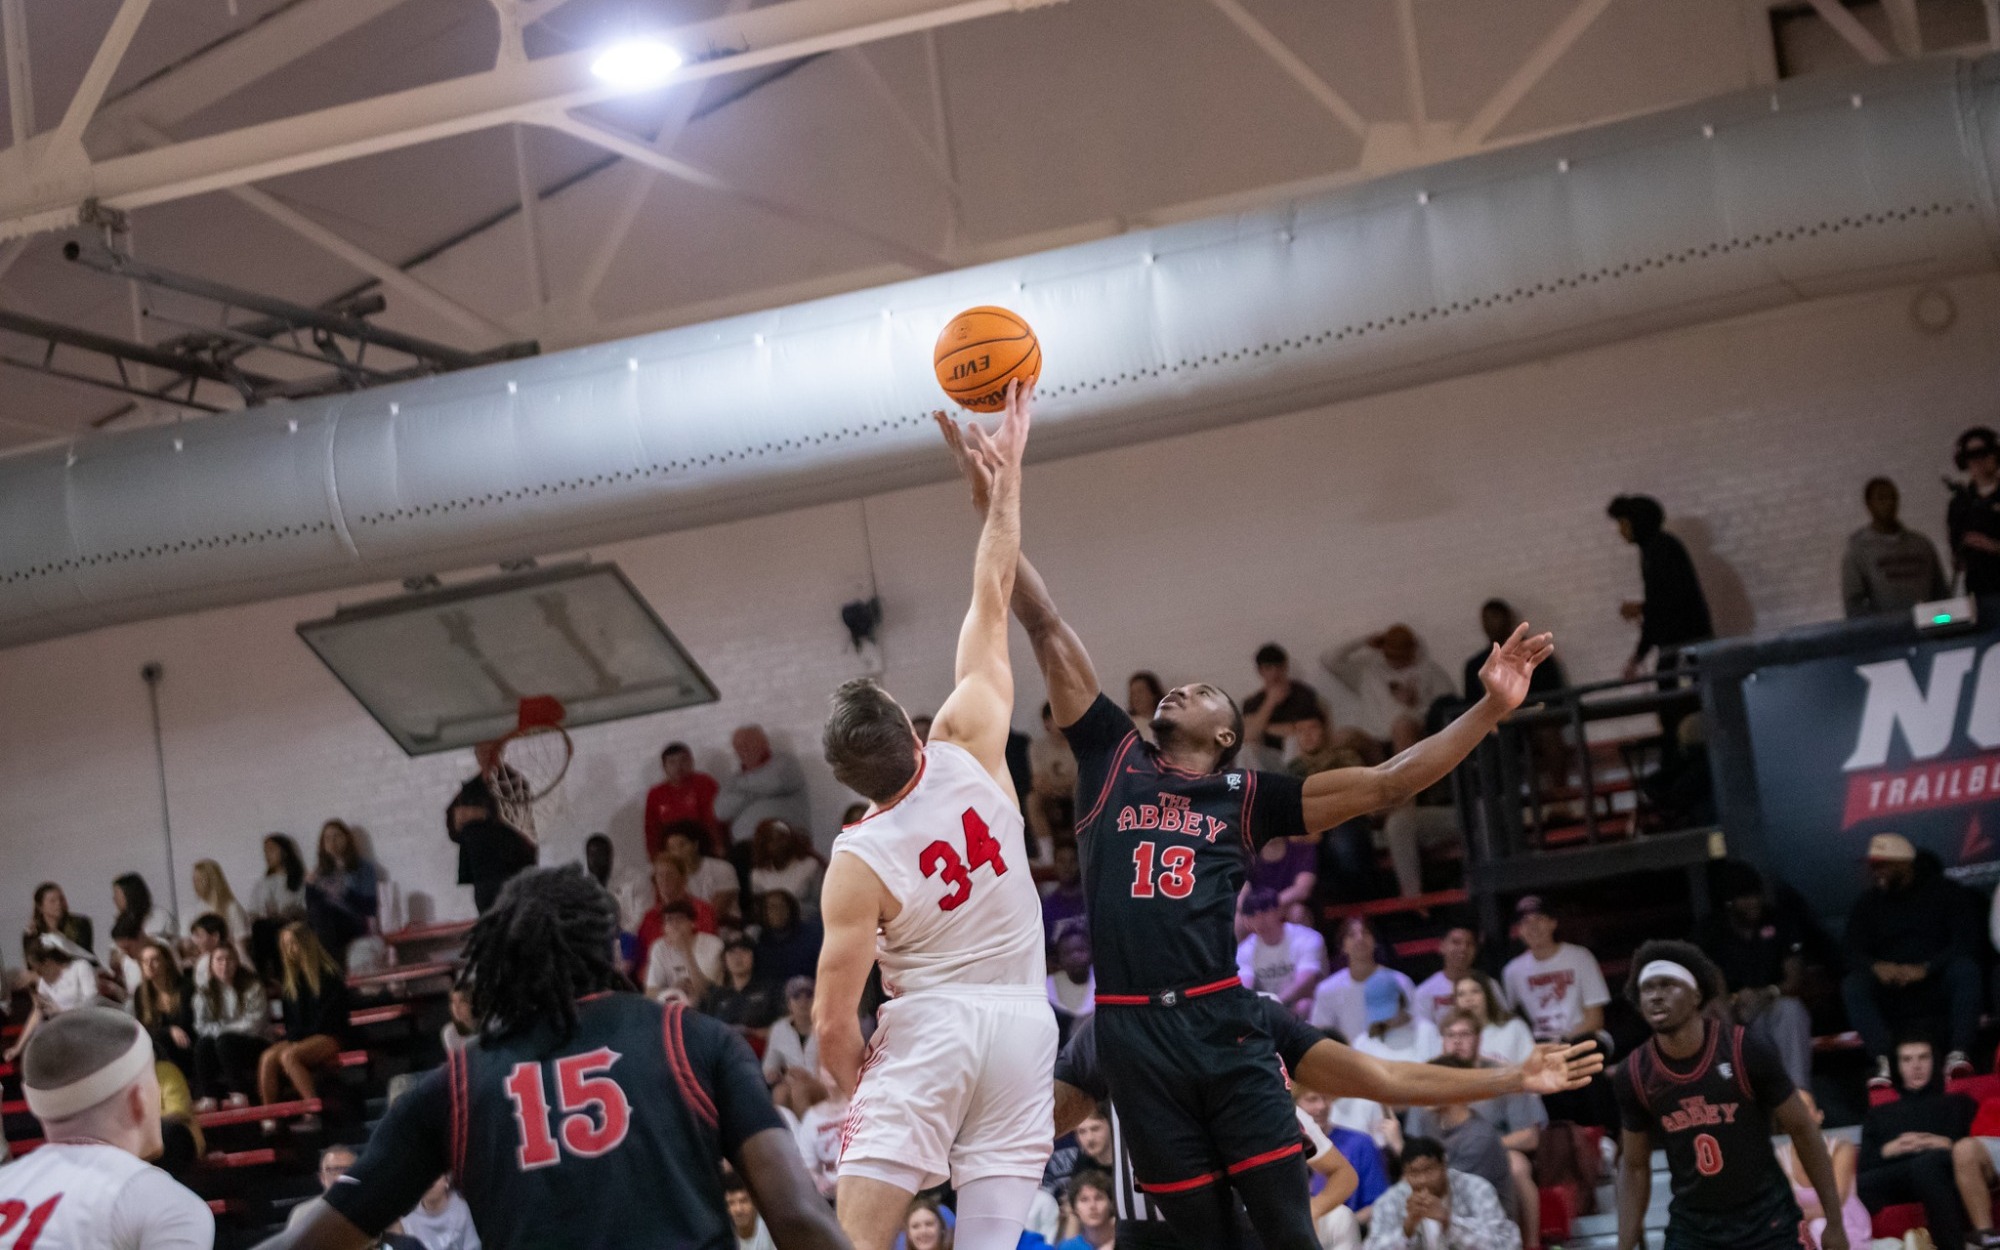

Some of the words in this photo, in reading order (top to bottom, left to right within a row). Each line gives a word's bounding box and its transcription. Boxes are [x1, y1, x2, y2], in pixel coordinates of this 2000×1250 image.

[1117, 804, 1228, 844] ABBEY
[1157, 791, 1192, 811] THE
[919, 806, 1008, 911] 34
[1131, 841, 1196, 899] 13
[505, 1046, 633, 1172] 15
[1694, 1133, 1724, 1176] 0
